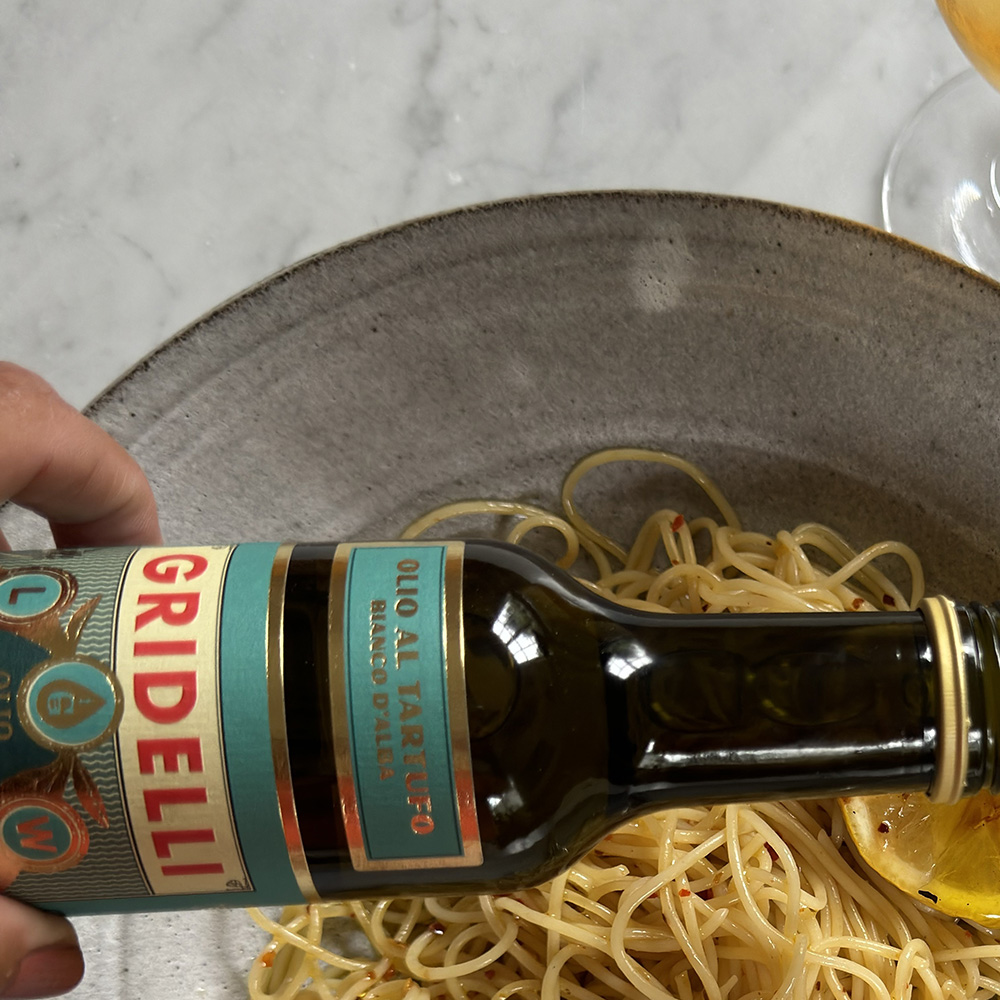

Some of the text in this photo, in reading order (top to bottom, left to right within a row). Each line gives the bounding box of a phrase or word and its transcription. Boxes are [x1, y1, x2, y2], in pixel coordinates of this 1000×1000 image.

[132, 553, 225, 877] GRIDELLI
[369, 598, 396, 782] BIANCO D'ALBA
[393, 558, 436, 836] OLIO AL TARTUFO
